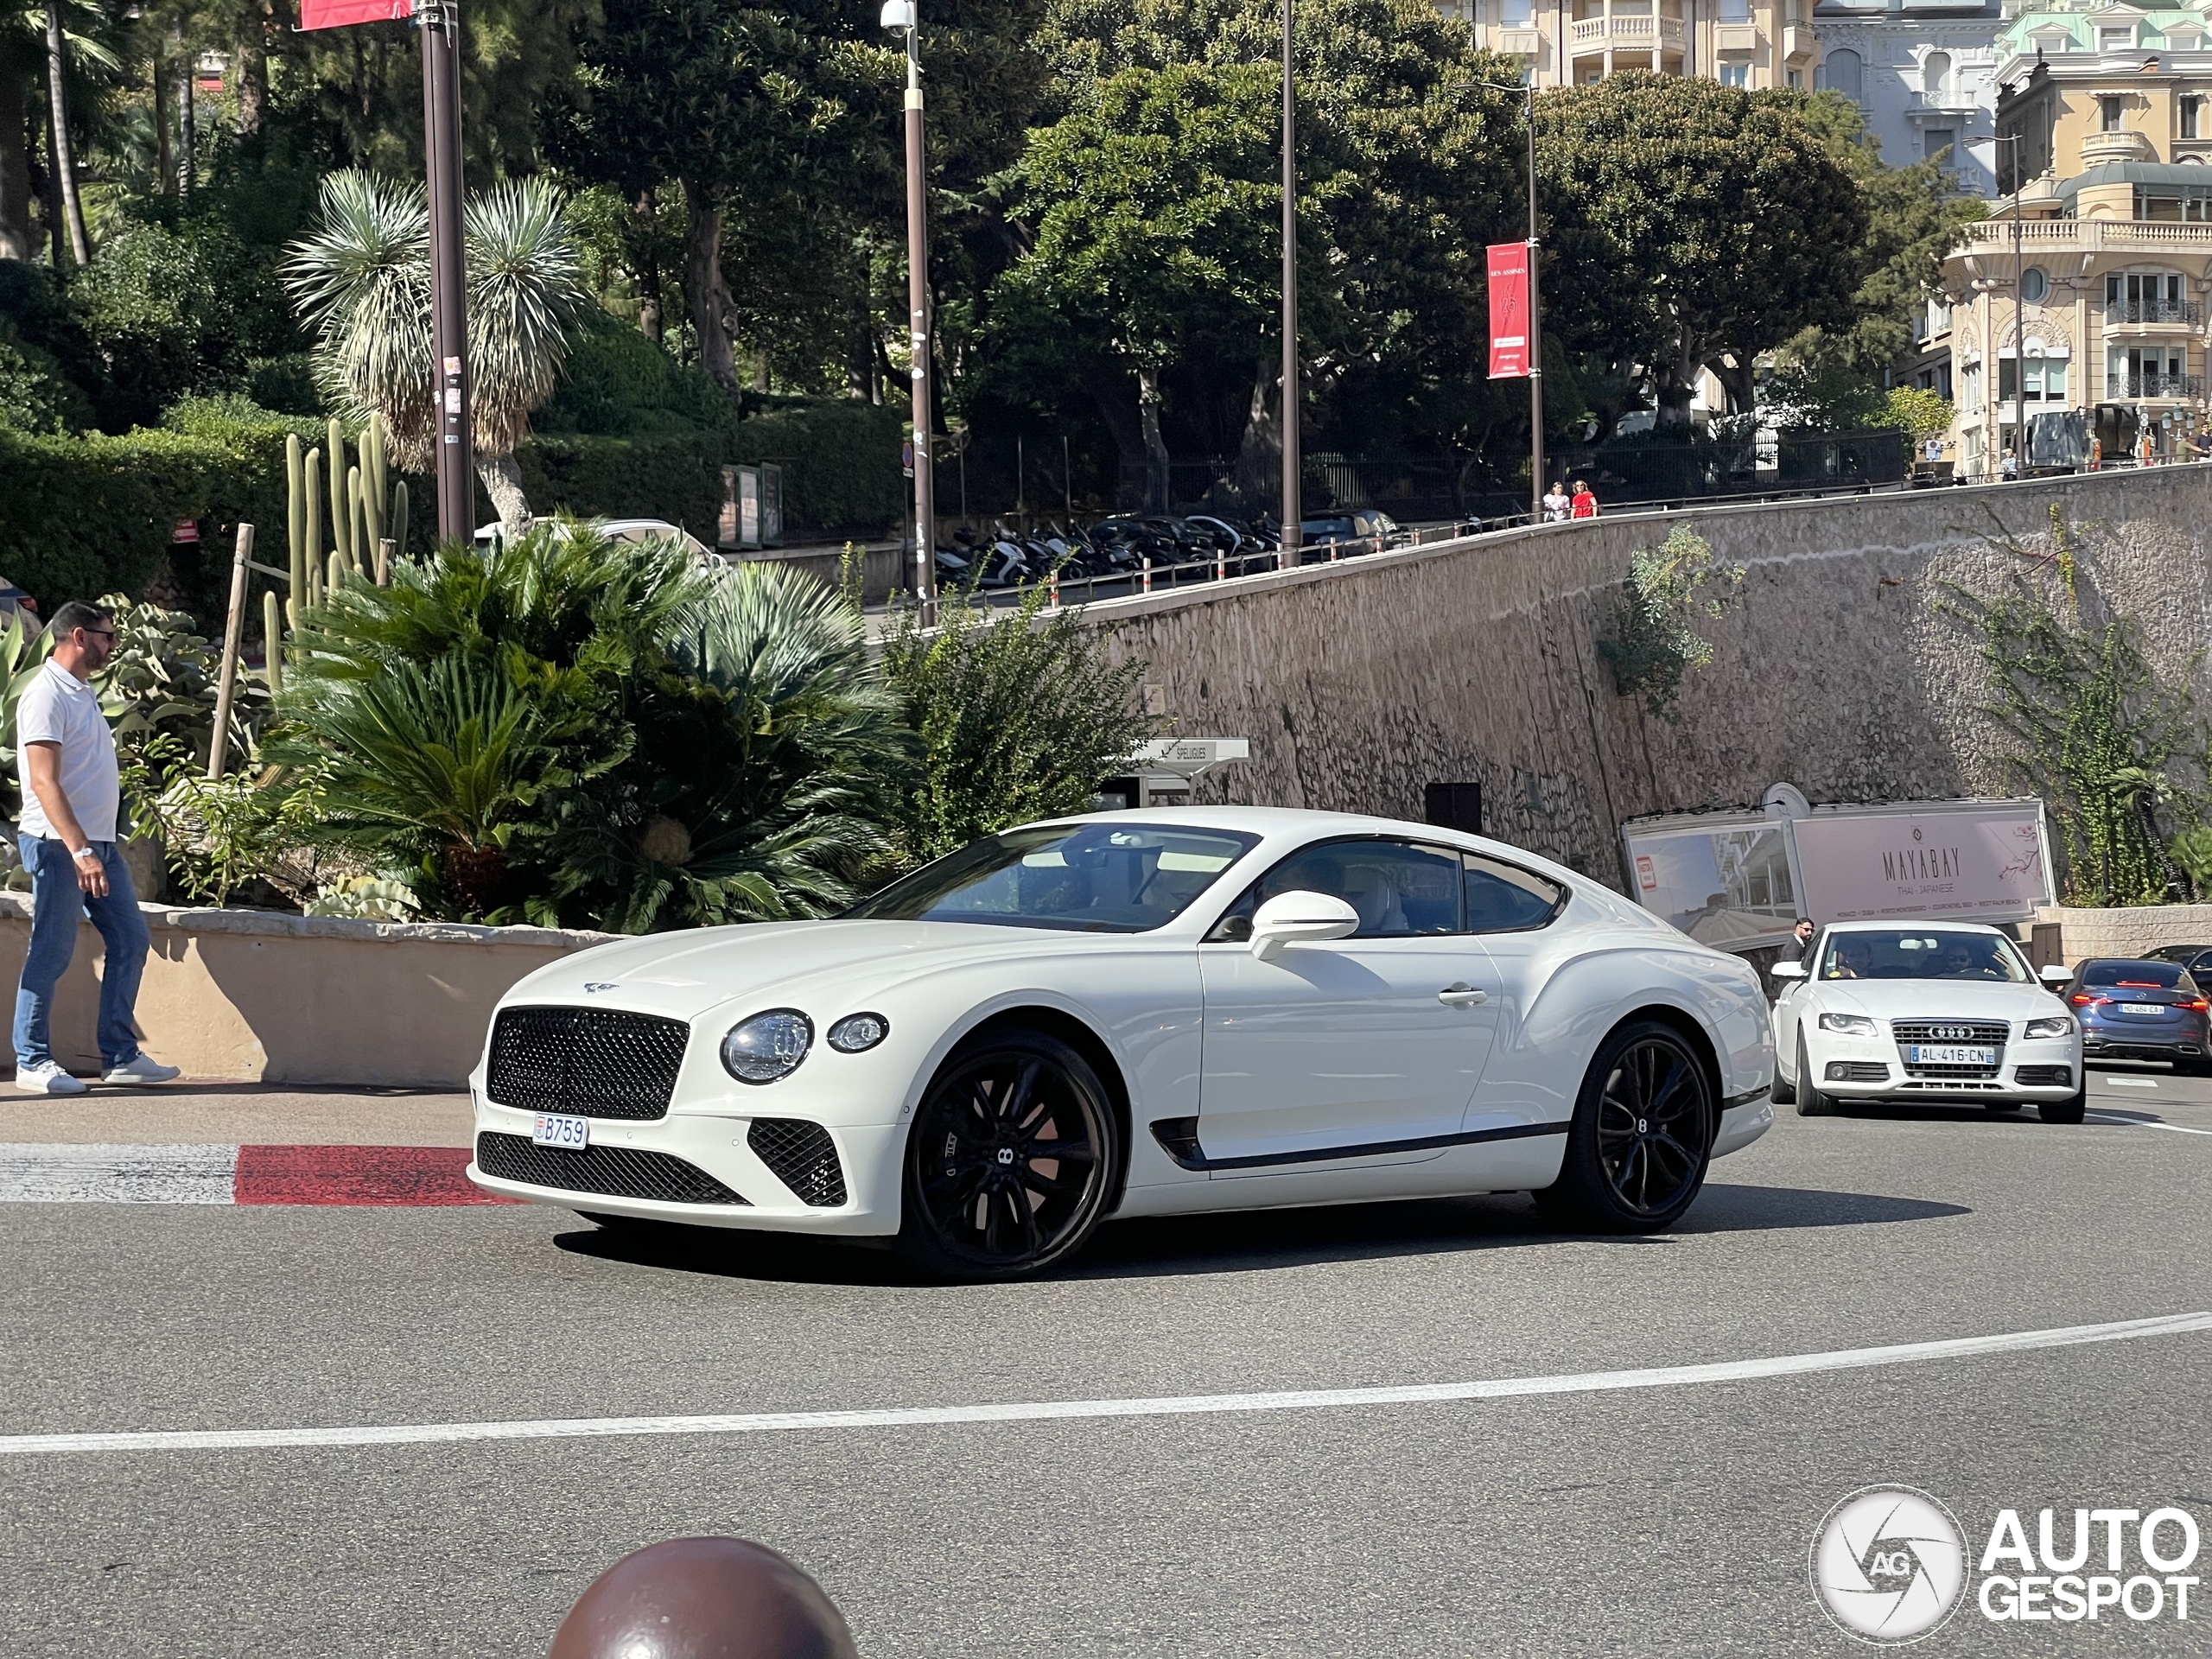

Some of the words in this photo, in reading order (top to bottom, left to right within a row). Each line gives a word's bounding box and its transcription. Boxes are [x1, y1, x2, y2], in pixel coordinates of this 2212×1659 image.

[1883, 847, 1959, 881] MAYABAY
[1897, 886, 1914, 896] THAI
[1919, 883, 1955, 894] JAPANESE
[1921, 1048, 1985, 1062] AL-416-CN
[545, 1117, 583, 1143] B759
